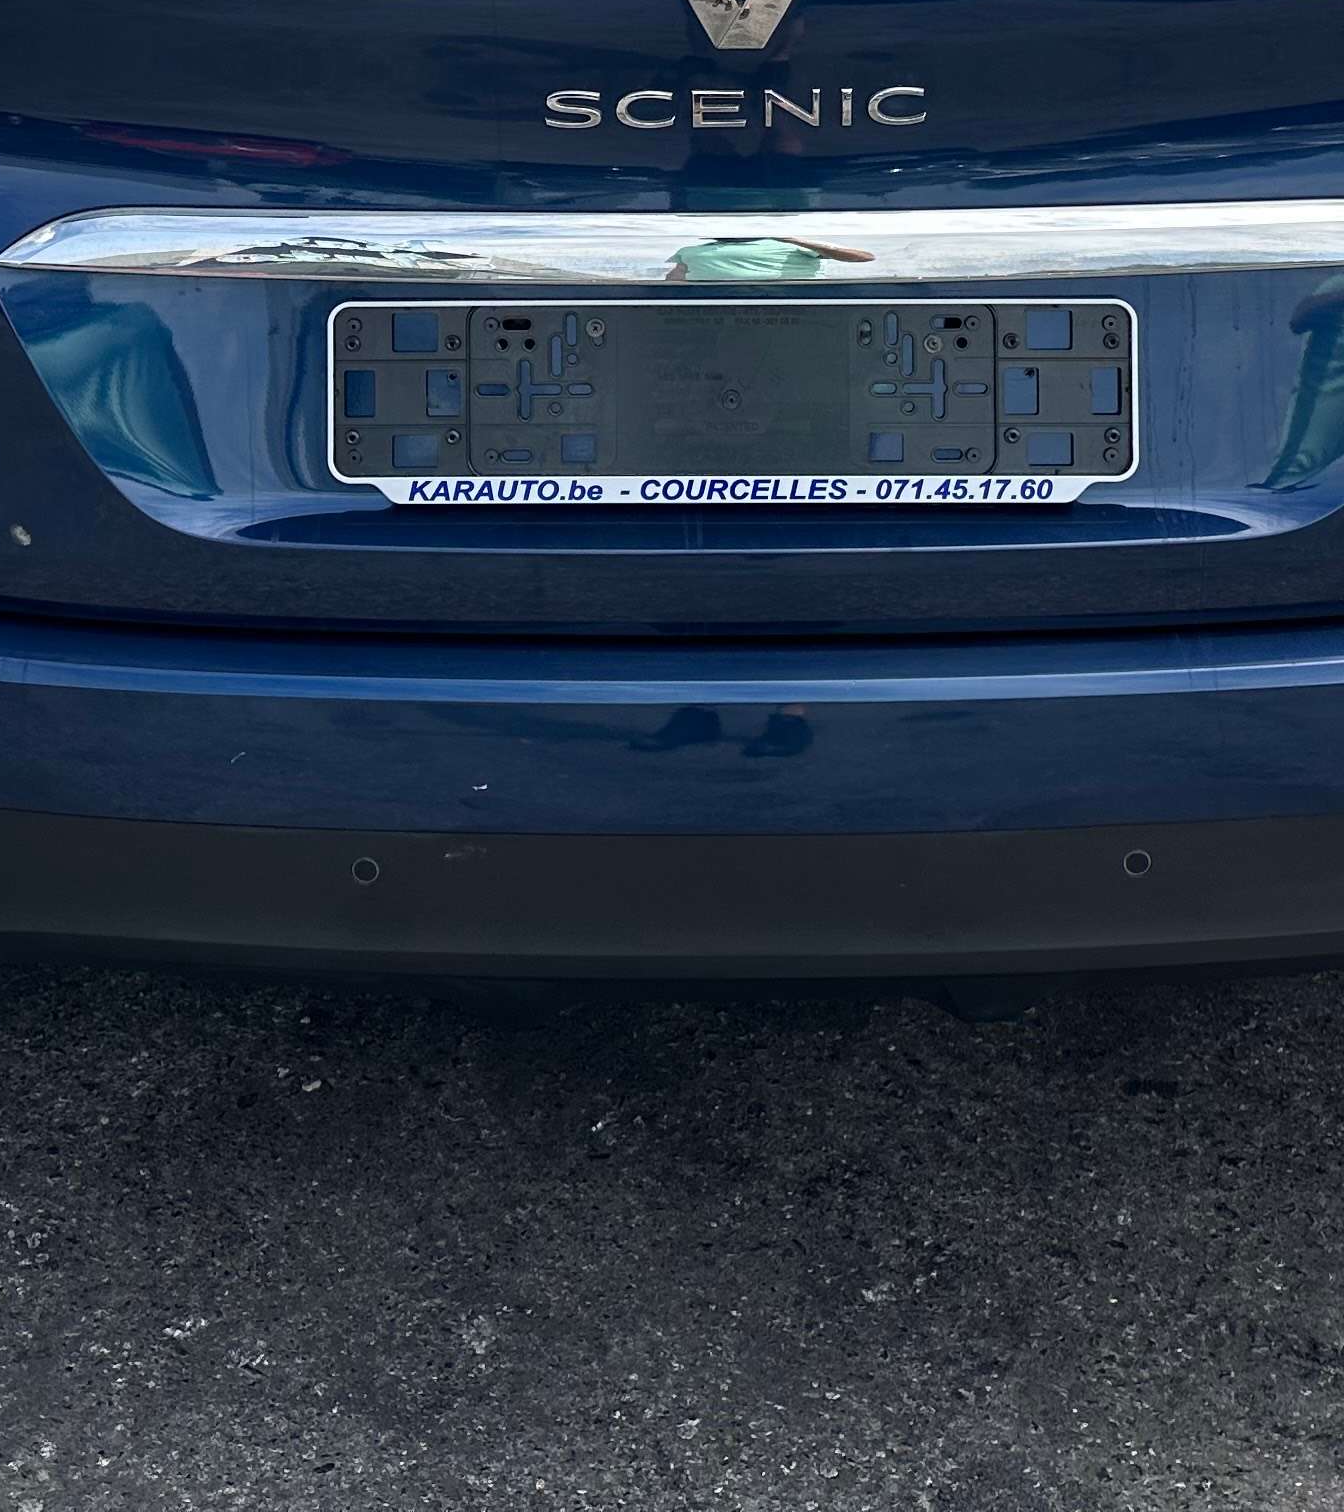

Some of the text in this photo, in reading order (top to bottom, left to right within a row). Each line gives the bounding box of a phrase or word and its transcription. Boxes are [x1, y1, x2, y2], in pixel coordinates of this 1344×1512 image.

[544, 86, 927, 129] SCENIC
[408, 480, 604, 501] KARAUTO.be
[640, 479, 848, 501] COURCELLES
[875, 479, 1054, 501] 071.45.17.60
